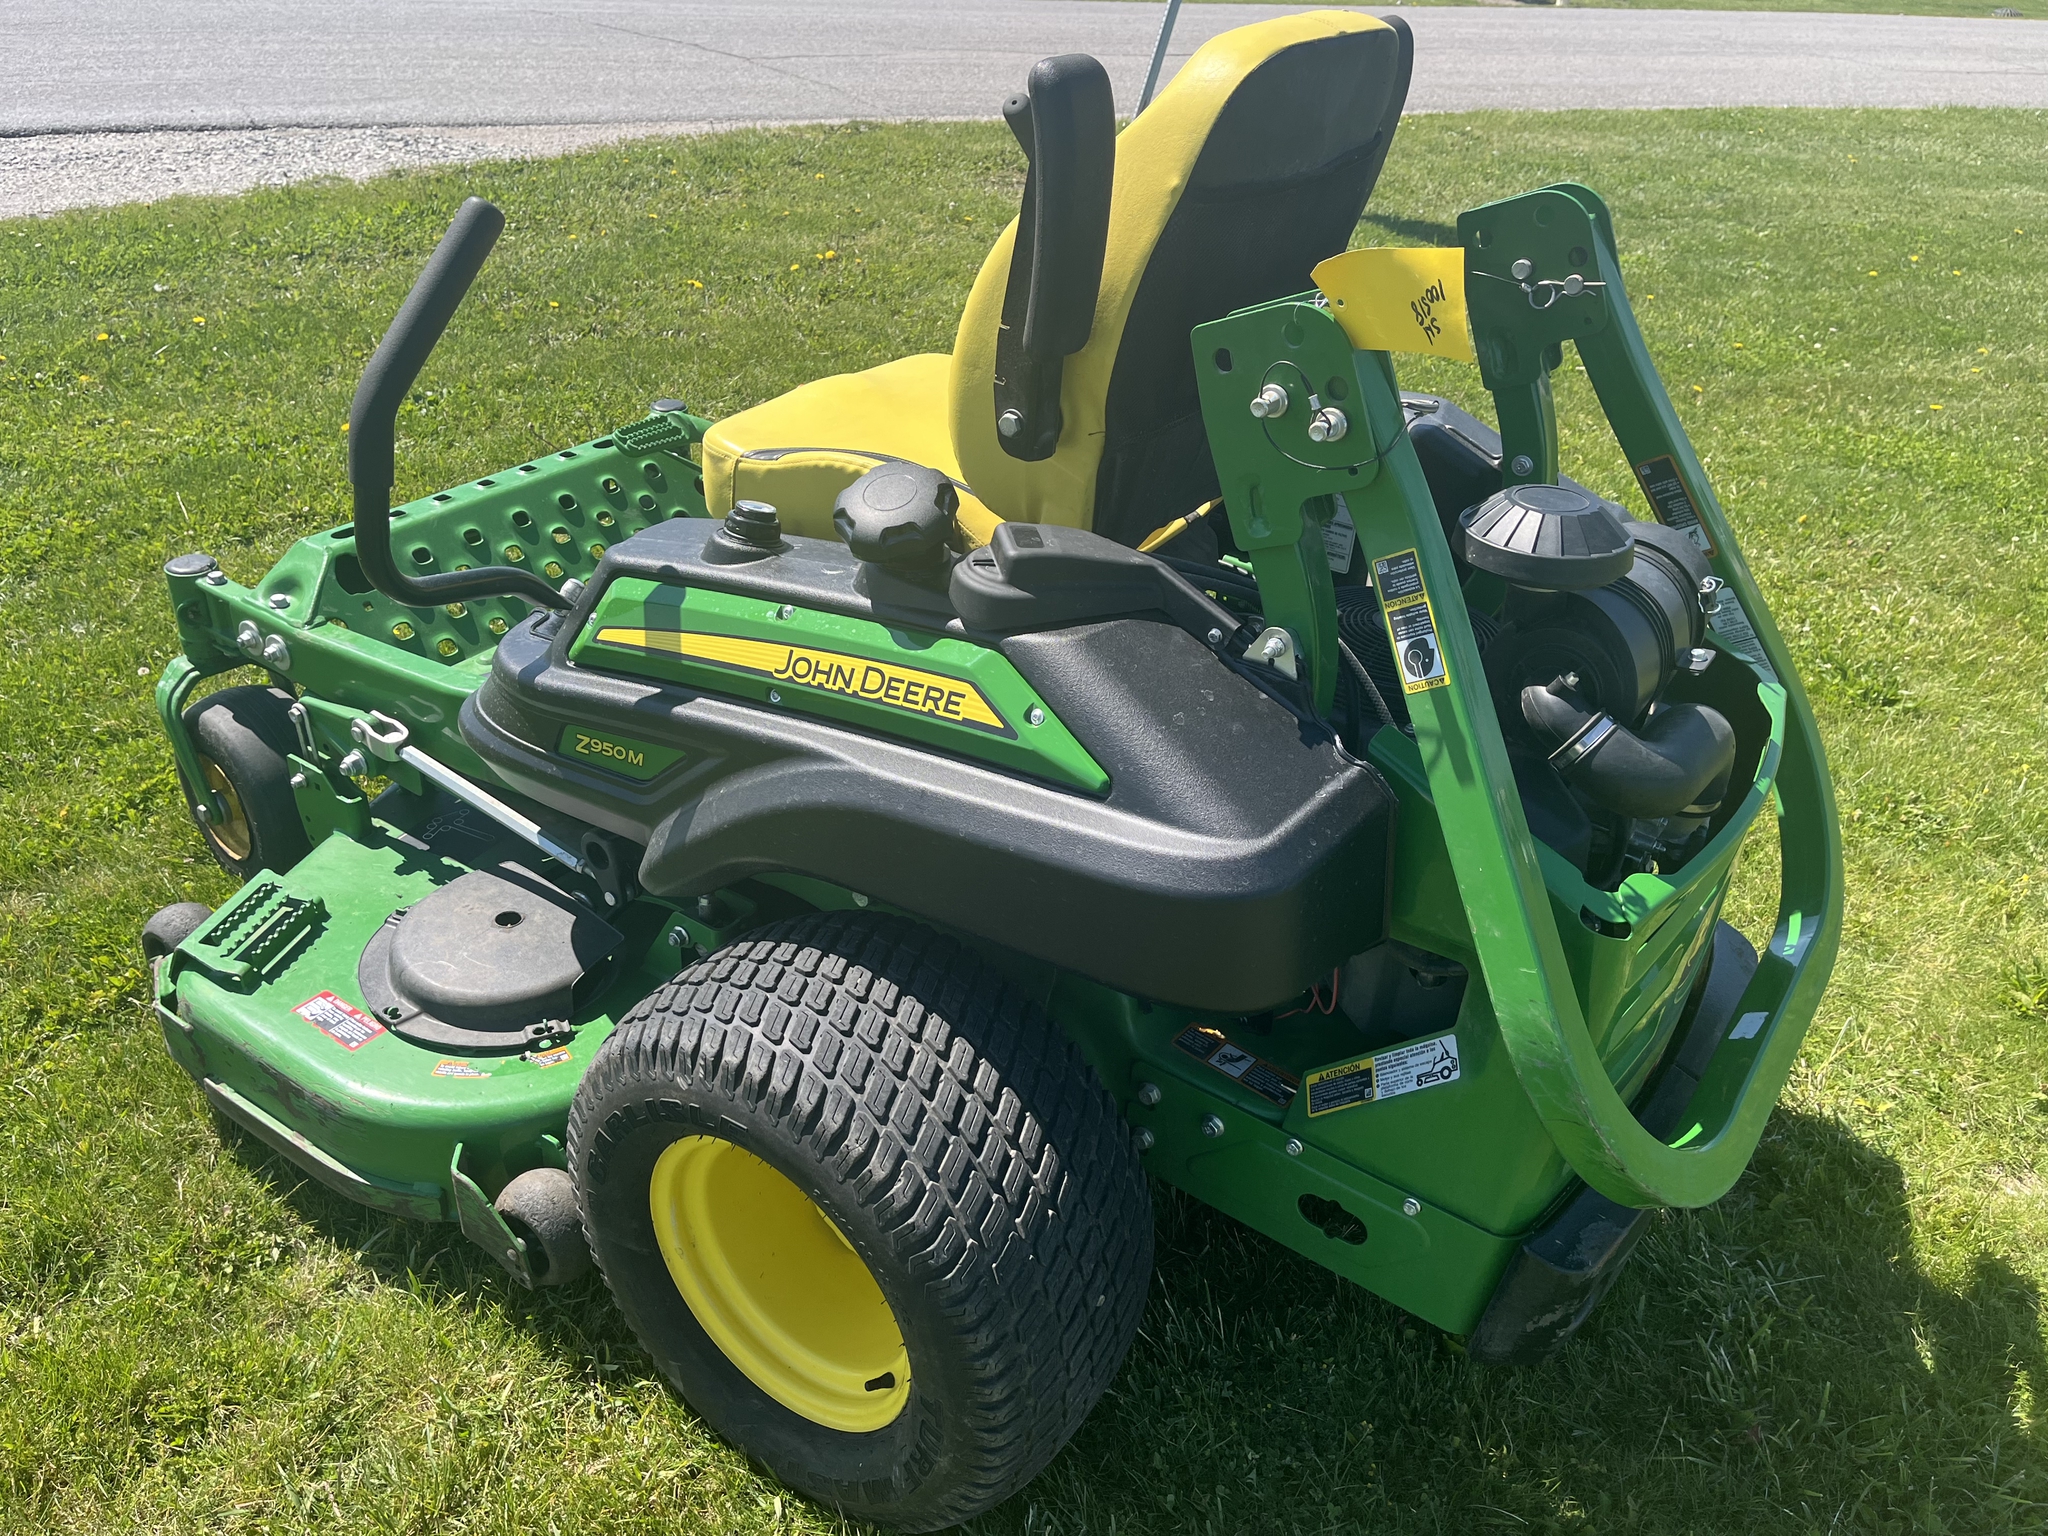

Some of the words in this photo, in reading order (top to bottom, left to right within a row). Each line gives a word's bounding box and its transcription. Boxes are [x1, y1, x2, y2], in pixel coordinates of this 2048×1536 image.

[773, 649, 853, 690] JOHN
[860, 666, 967, 716] DEERE
[1408, 678, 1440, 692] CAUTION
[575, 733, 645, 767] Z950M
[1326, 1062, 1361, 1078] ATENCIÓN
[587, 1097, 750, 1184] CARLISLE
[903, 1394, 946, 1496] TURF
